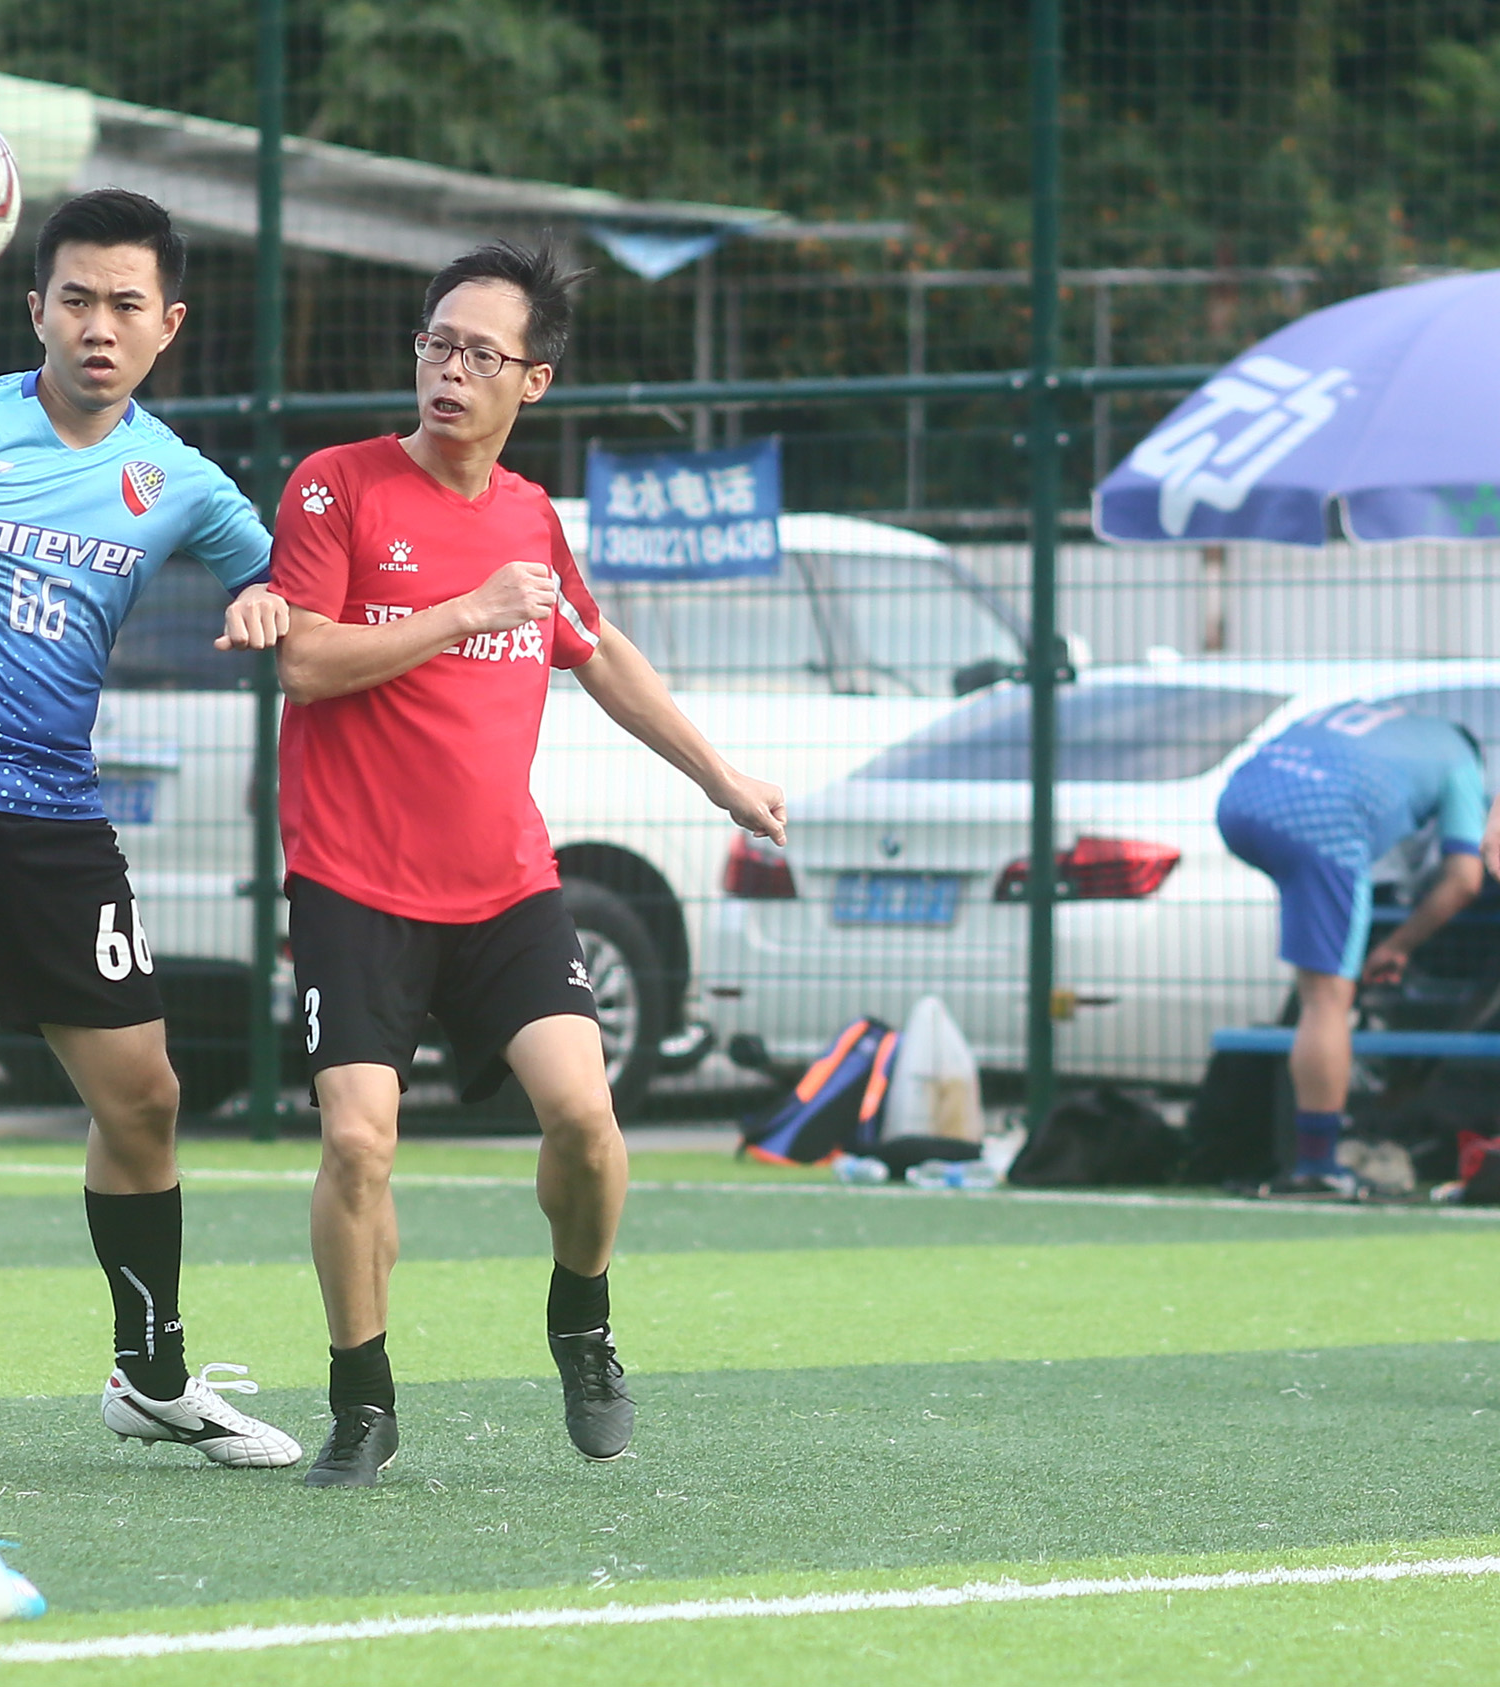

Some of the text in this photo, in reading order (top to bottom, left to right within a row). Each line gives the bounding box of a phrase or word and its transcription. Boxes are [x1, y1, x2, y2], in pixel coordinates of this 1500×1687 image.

[379, 562, 419, 572] KELME
[9, 568, 72, 641] 66
[93, 897, 155, 982] 66
[304, 986, 321, 1055] 3
